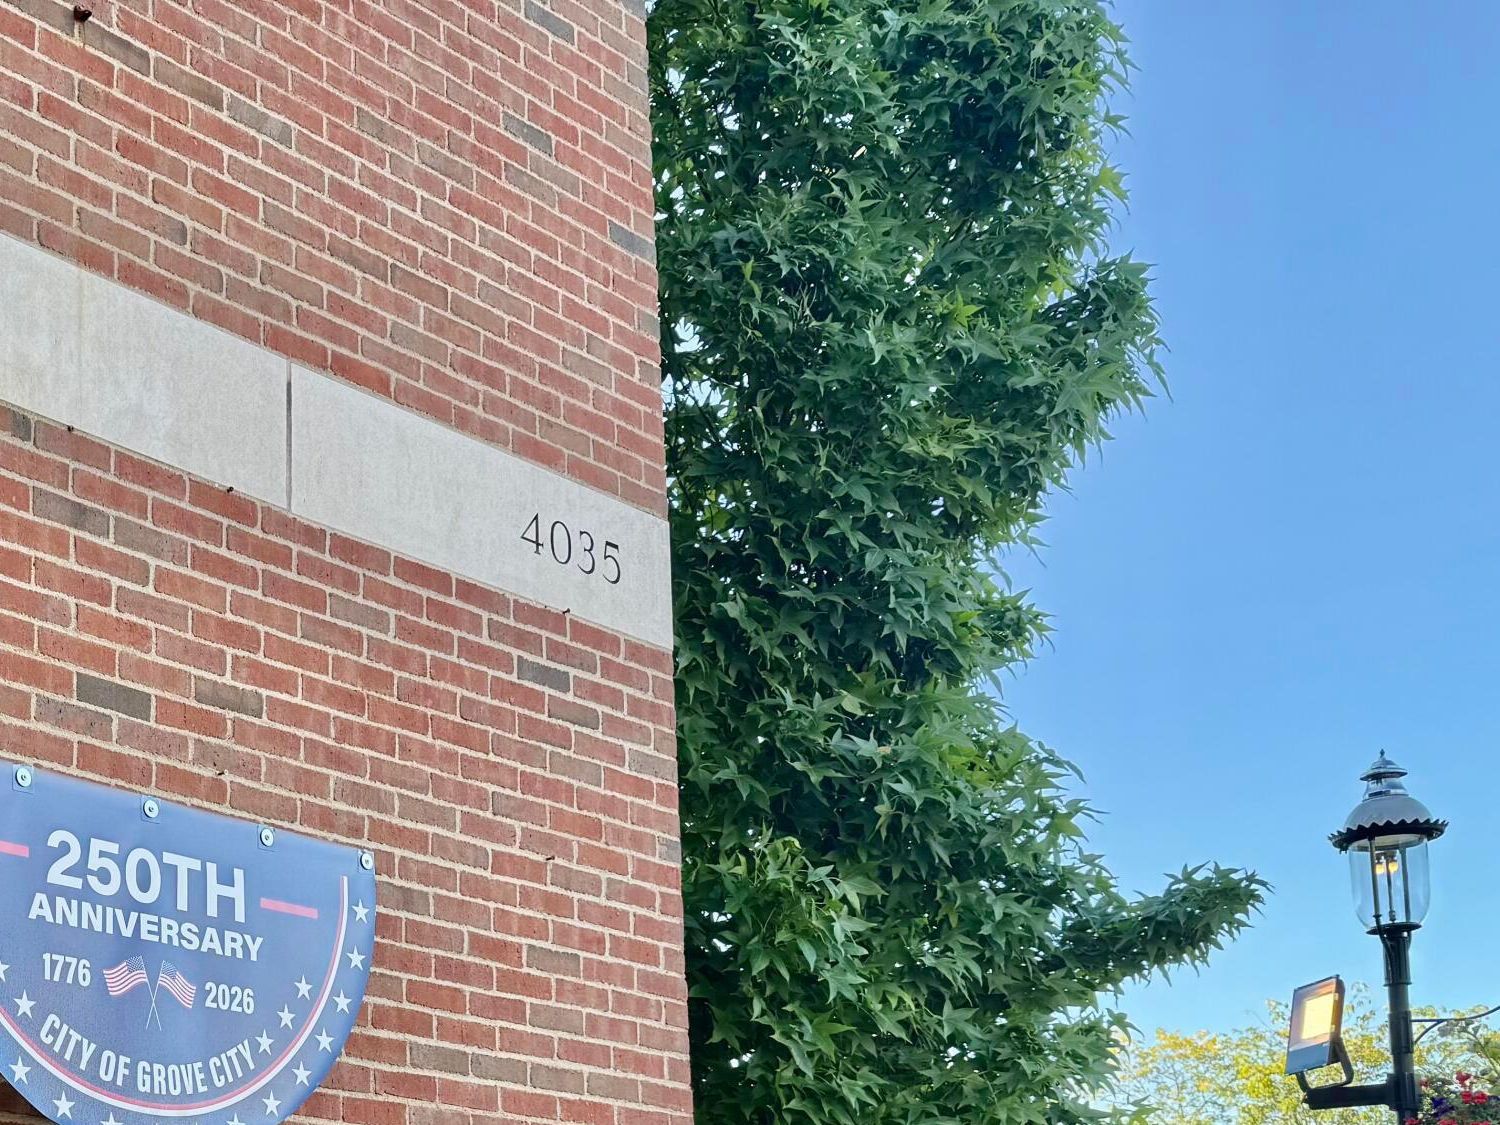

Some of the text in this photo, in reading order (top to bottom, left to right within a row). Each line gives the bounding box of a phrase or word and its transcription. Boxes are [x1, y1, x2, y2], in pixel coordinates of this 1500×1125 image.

[520, 512, 621, 585] 4035
[46, 829, 245, 923] 250TH
[28, 892, 263, 962] ANNIVERSARY
[42, 952, 255, 1015] 1776 2026
[39, 1013, 256, 1096] CITY OF GROVE CITY
